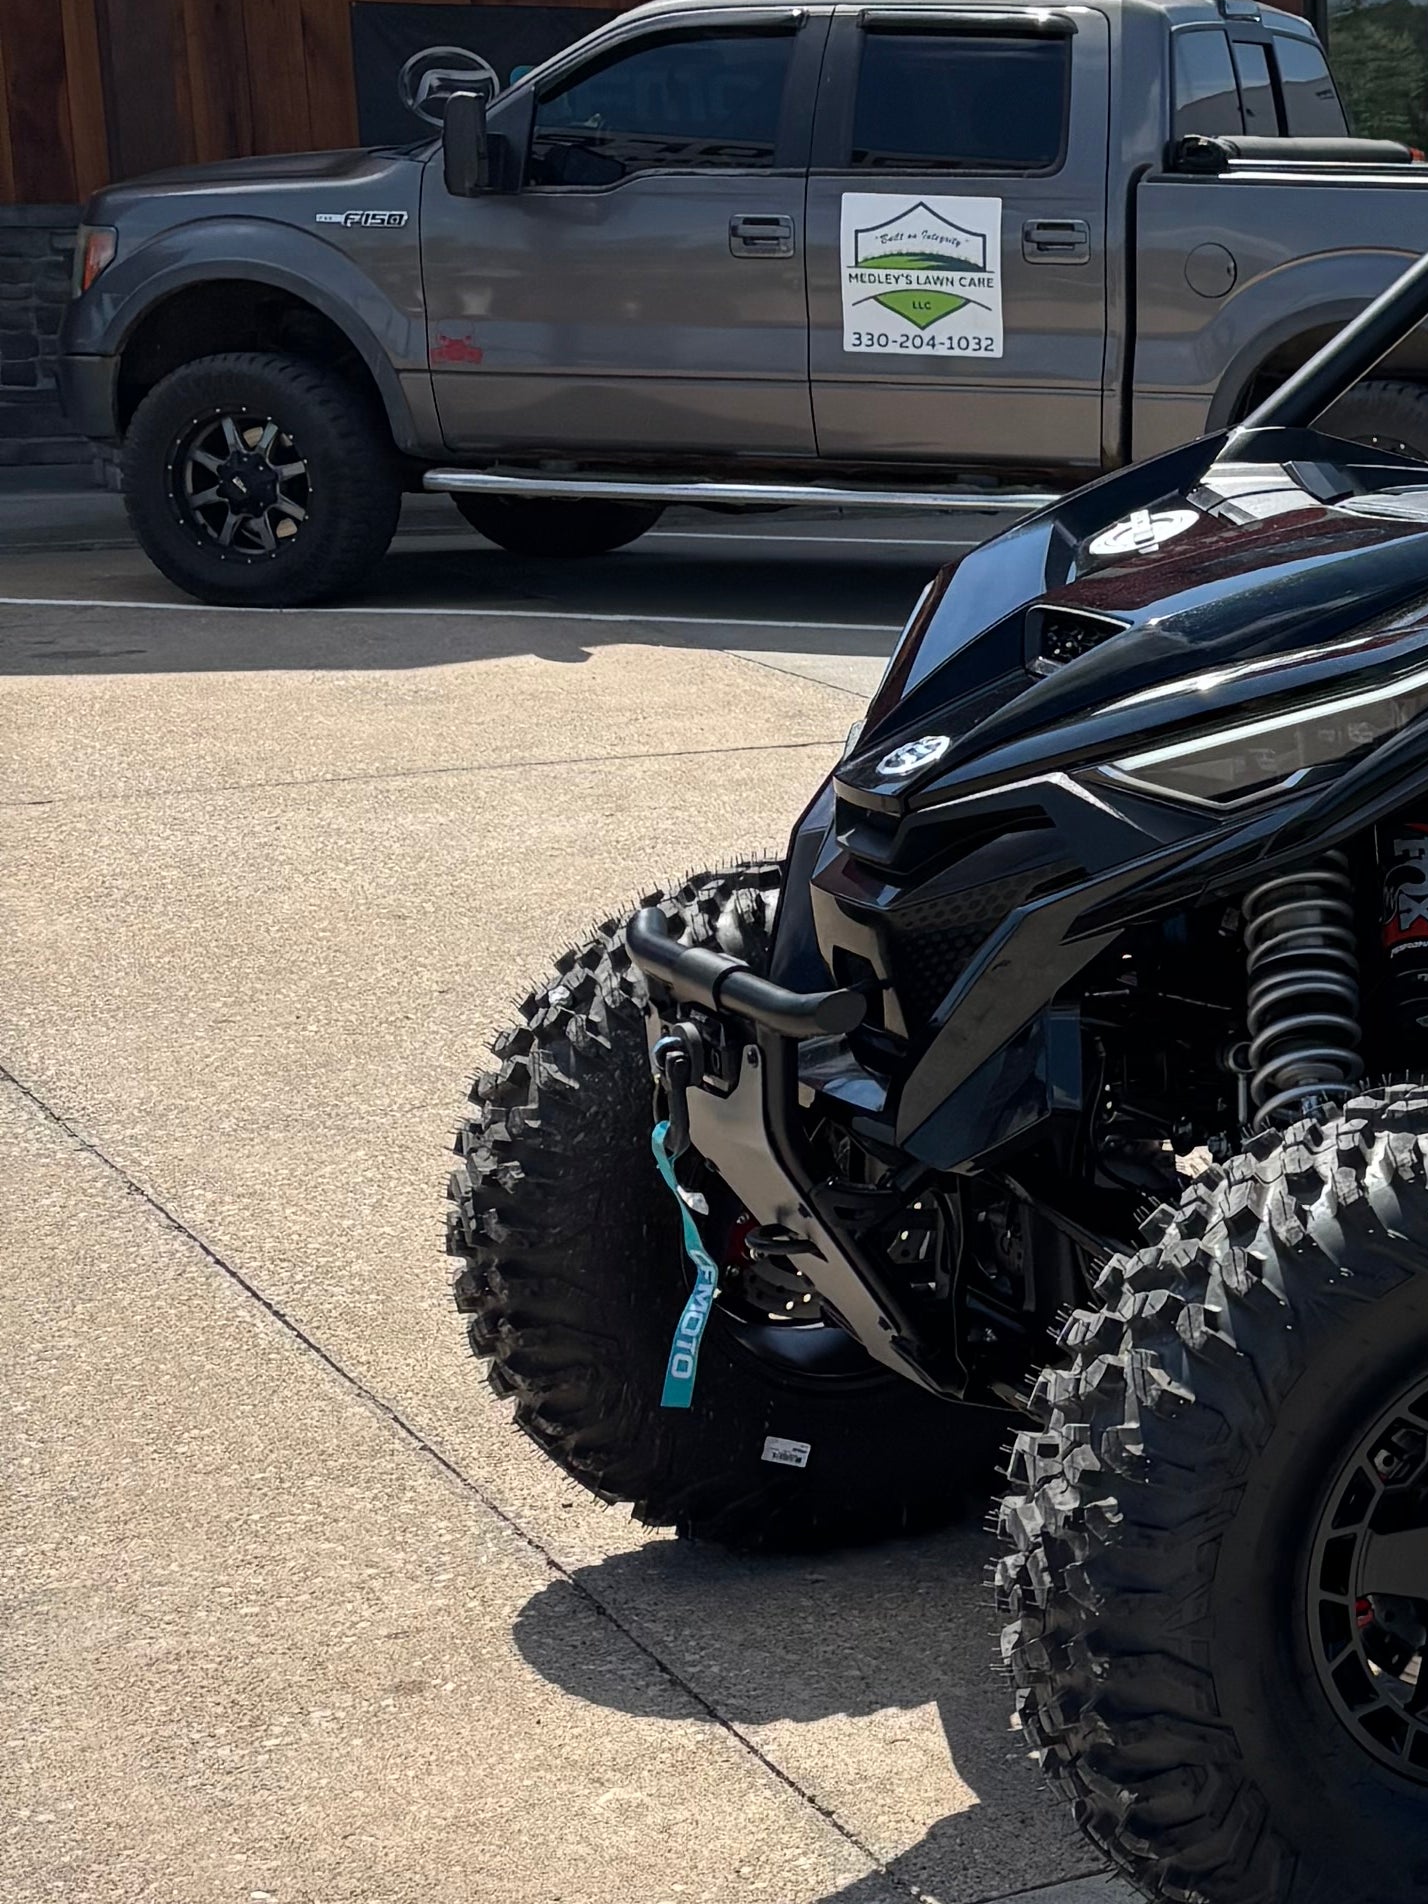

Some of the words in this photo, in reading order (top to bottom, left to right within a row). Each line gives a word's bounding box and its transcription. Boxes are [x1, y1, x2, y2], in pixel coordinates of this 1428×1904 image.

[848, 273, 913, 285] MEDLEY'S
[916, 275, 955, 287] LAWN
[958, 277, 995, 288] CARE
[912, 301, 932, 310] LLC
[852, 332, 995, 352] 330-204-1032
[671, 1249, 716, 1379] CFMOTO
